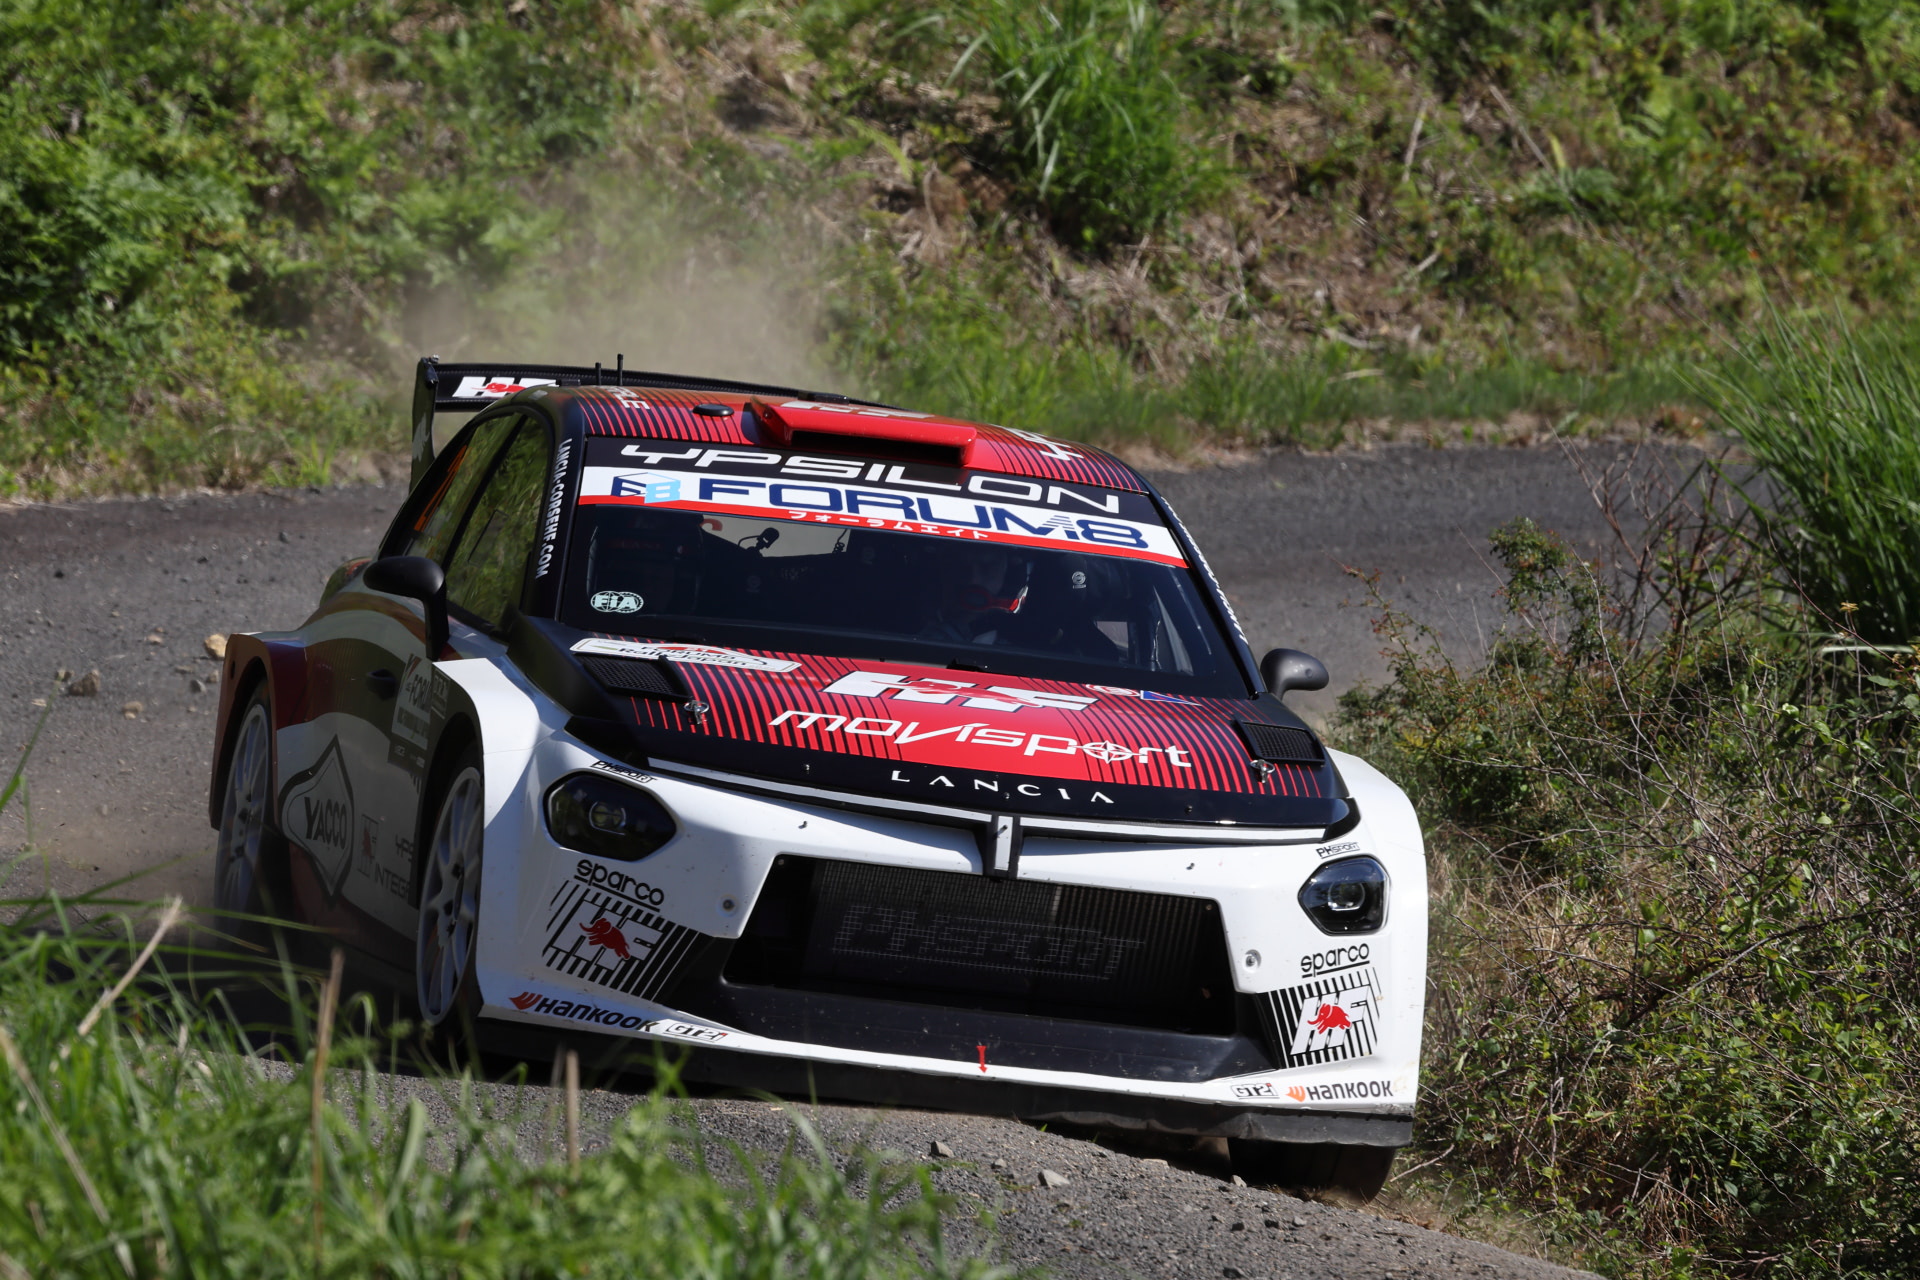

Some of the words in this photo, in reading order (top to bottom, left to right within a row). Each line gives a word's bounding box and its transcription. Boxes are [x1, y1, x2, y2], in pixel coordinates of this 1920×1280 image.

[621, 444, 1120, 514] YPSILON
[699, 477, 1149, 549] FORUM8
[788, 510, 989, 539] フォーラムエイト
[891, 770, 1114, 804] LANCIA
[575, 859, 665, 907] sparco
[1301, 943, 1371, 977] sparco
